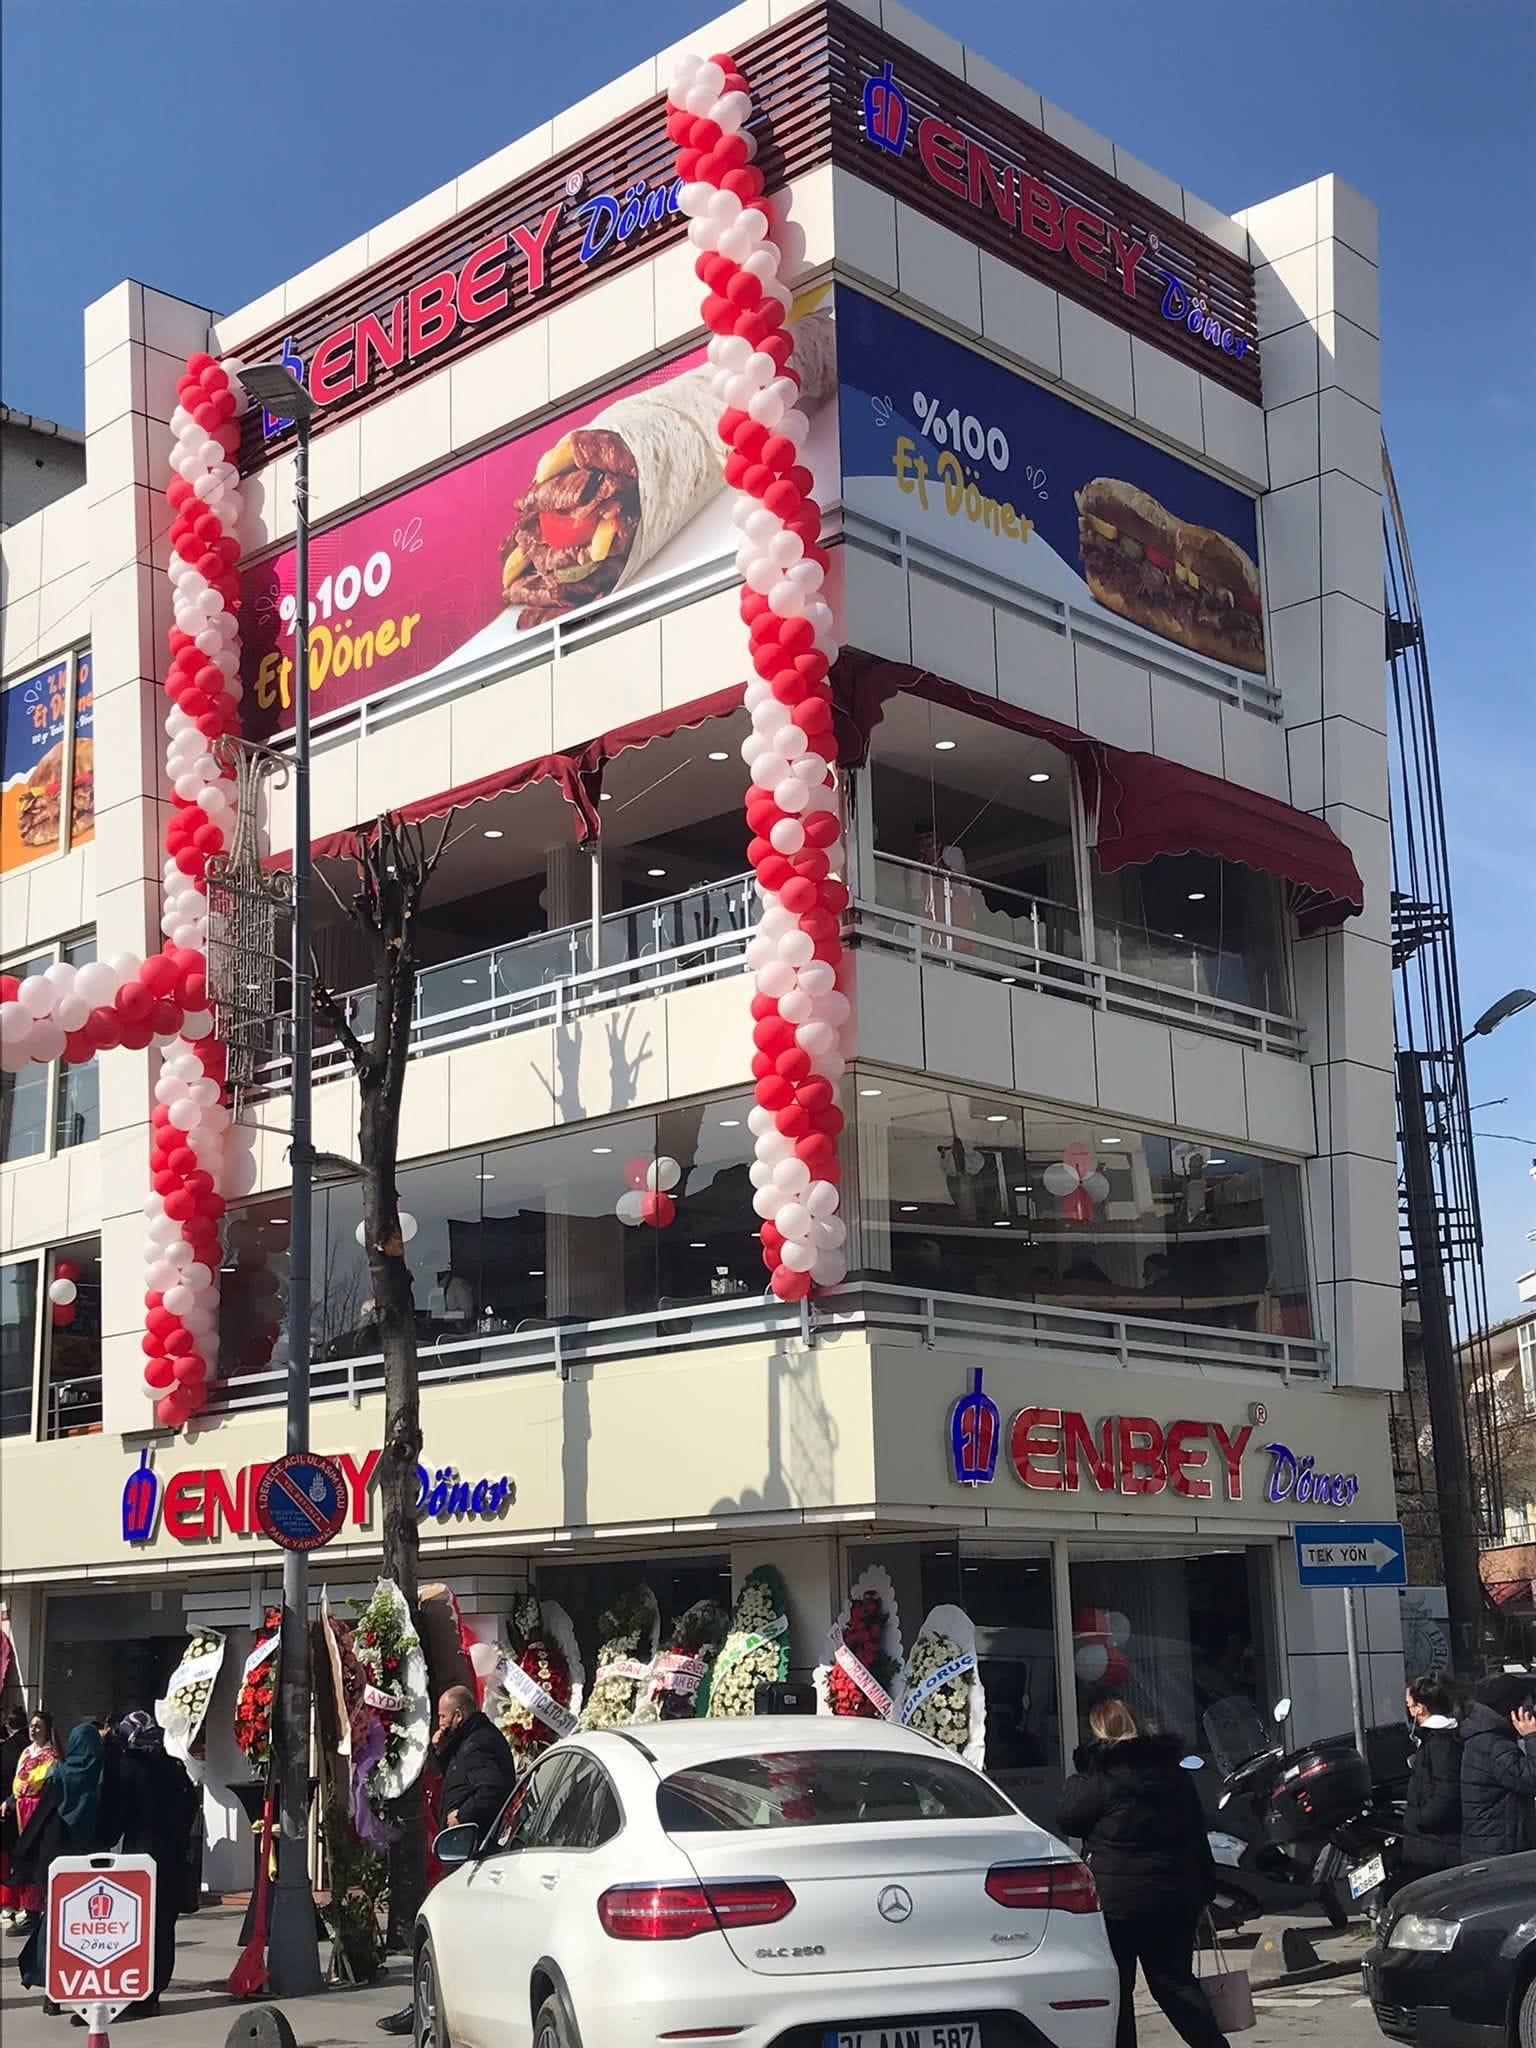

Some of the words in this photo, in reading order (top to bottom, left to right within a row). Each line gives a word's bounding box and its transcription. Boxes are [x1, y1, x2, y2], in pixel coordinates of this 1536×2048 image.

[918, 116, 1147, 298] ENBEY
[1157, 268, 1250, 360] Döner
[308, 203, 563, 405] ENBEY
[912, 391, 1010, 472] %100
[892, 436, 929, 512] Et
[937, 450, 1035, 545] Döner
[254, 652, 293, 709] Et
[308, 613, 421, 692] Döner
[163, 1450, 383, 1541] ENY
[1010, 1406, 1254, 1501] ENBEY
[1259, 1442, 1360, 1507] Döner
[1308, 1549, 1334, 1562] TEK
[1340, 1545, 1368, 1562] YÖN
[70, 1921, 130, 1935] ENBEY
[80, 1938, 120, 1950] Döner
[58, 1968, 141, 1996] VALE
